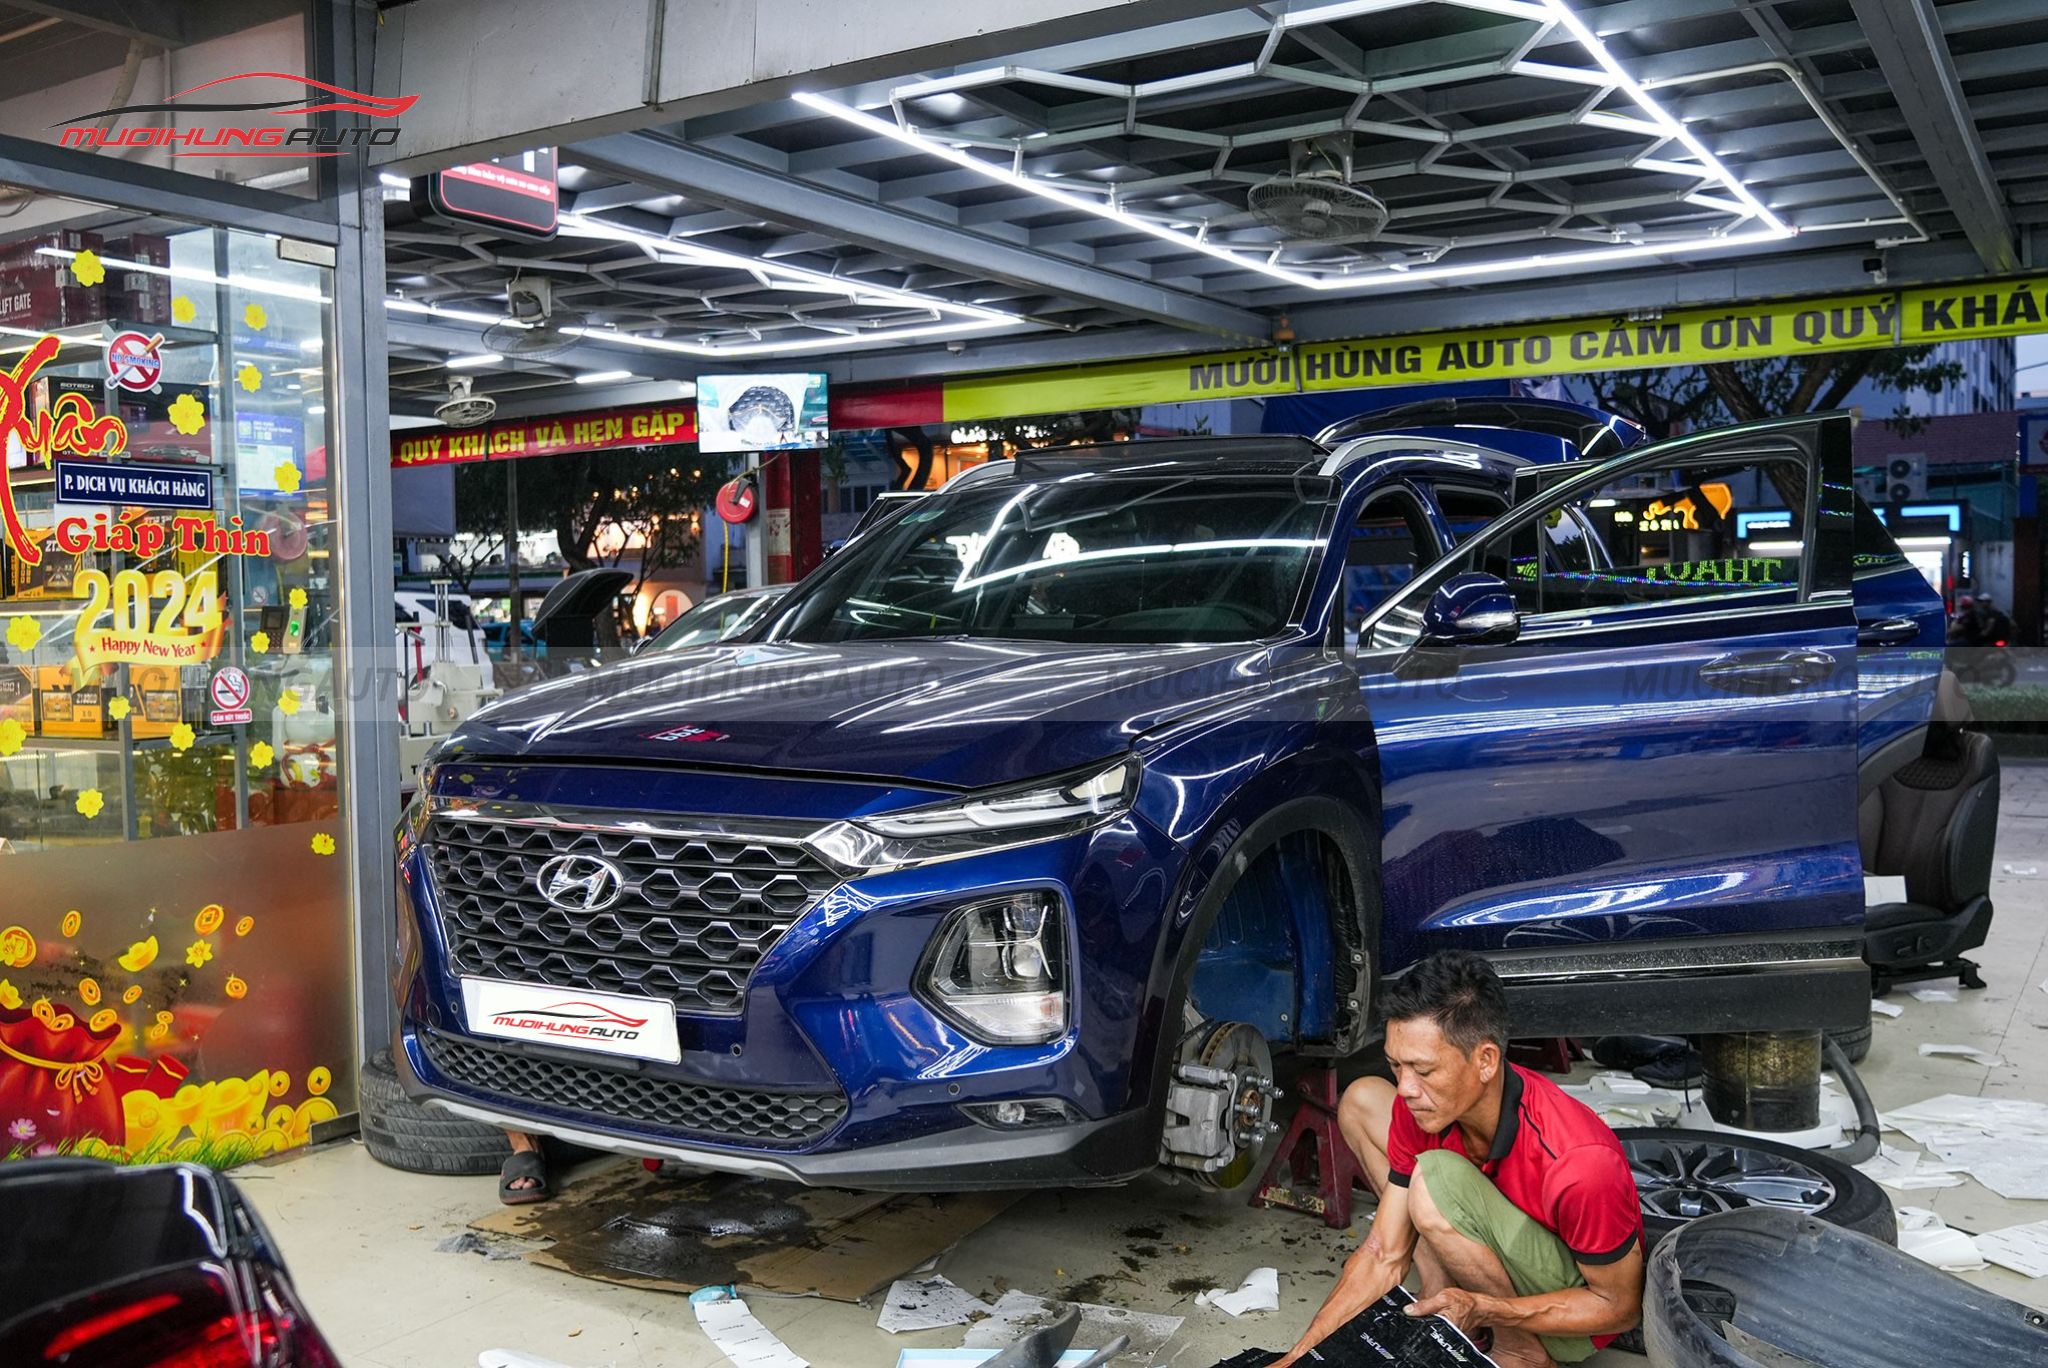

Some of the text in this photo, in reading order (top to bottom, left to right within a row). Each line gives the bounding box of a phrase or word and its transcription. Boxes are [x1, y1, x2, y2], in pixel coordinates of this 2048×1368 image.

[14, 292, 32, 311] GATE
[1189, 284, 2048, 391] MƯỜI HÙNG AUTO CẢM ƠN QUÝ KHÁ
[112, 352, 160, 369] NO SMOKING
[400, 435, 442, 464] QUÝ
[535, 419, 567, 448] VÀ
[574, 417, 624, 446] HẸN
[631, 409, 685, 441] GẶP
[64, 475, 205, 497] P. DỊCH VỤ KHÁCH HÀNG
[56, 512, 271, 559] Giáp Thìn
[73, 570, 223, 636] 2024
[101, 637, 196, 658] Happy New Year
